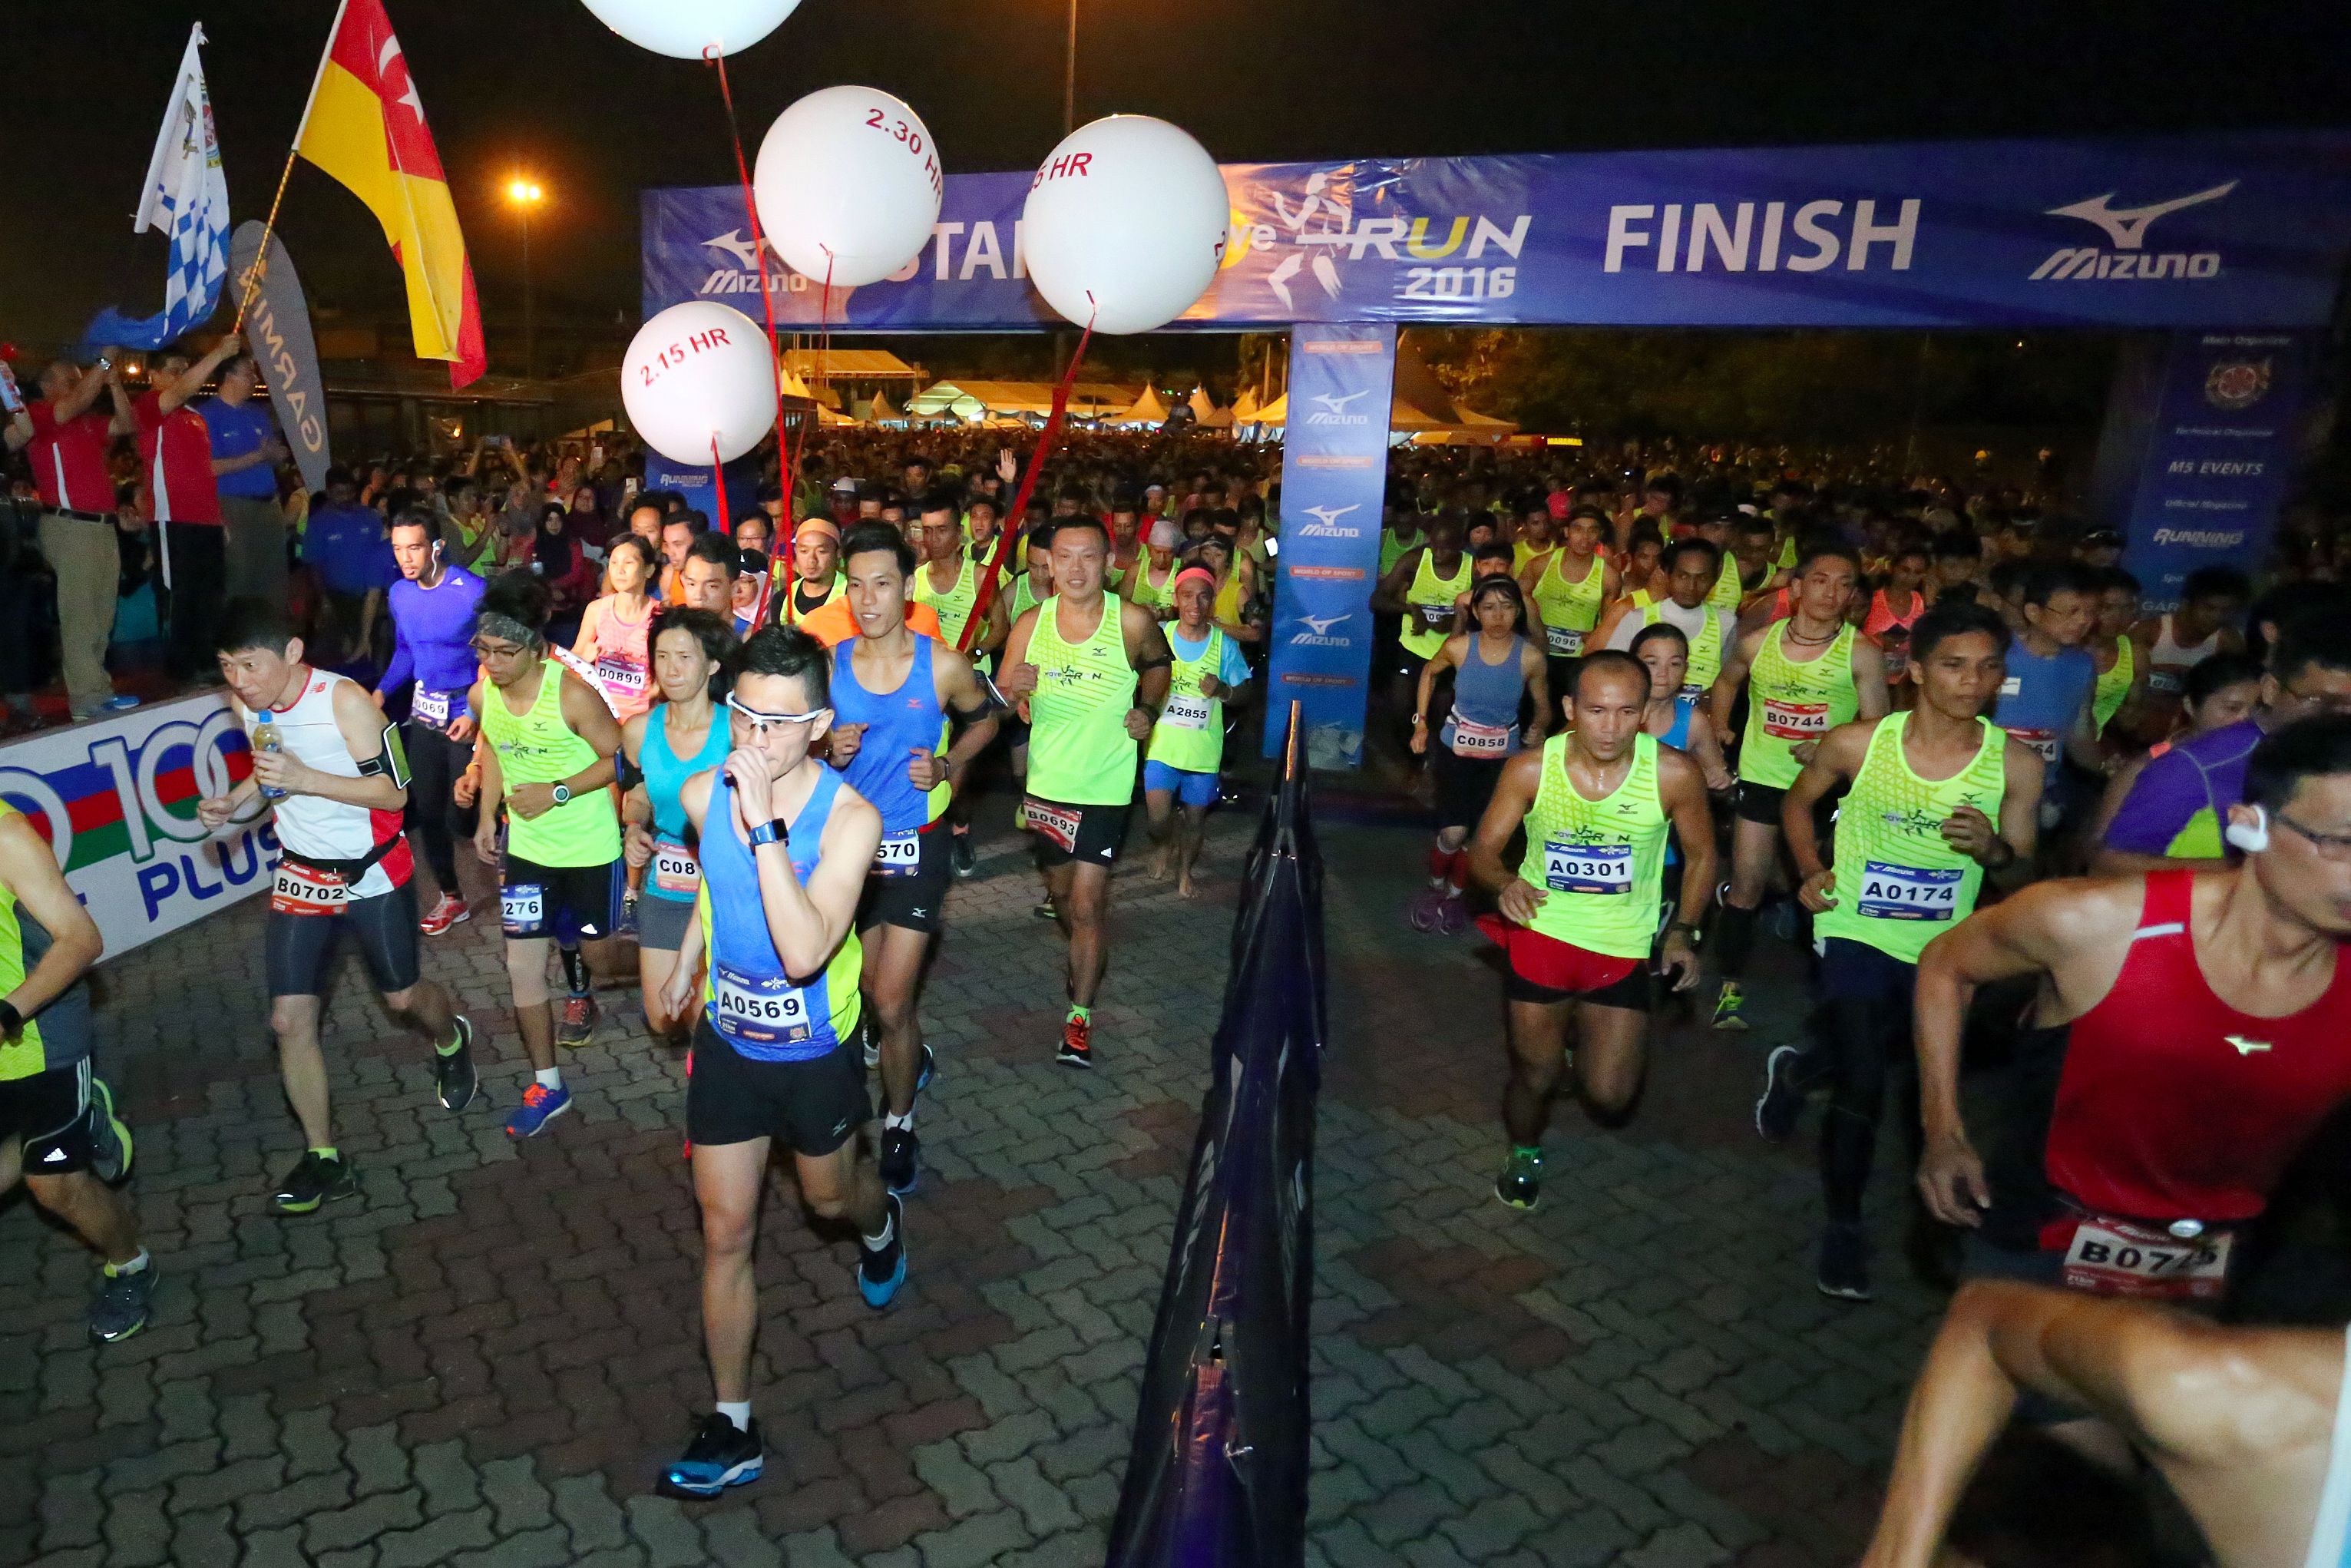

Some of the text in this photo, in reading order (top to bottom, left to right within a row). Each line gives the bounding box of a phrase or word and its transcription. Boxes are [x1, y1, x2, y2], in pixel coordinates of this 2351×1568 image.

[866, 108, 921, 154] 2.30
[1049, 153, 1093, 180] HR
[1348, 214, 1532, 260] RUN
[1604, 198, 1921, 273] FINISH
[2029, 247, 2221, 280] MIZUNO
[1404, 266, 1517, 299] 2016
[640, 328, 732, 386] 2.15 HR
[2199, 462, 2264, 476] EVENTS
[1299, 524, 1360, 538] MIZUNO
[2141, 601, 2181, 612] GAR
[1291, 632, 1351, 647] MIZUNO
[599, 667, 642, 685] D0899
[1167, 705, 1208, 719] A2855
[1767, 711, 1825, 727] B0744
[1027, 810, 1075, 836] B0693
[1549, 858, 1625, 876] A0301
[277, 877, 344, 900] B0702
[1864, 882, 1953, 901] A0174
[721, 991, 800, 1019] A0569
